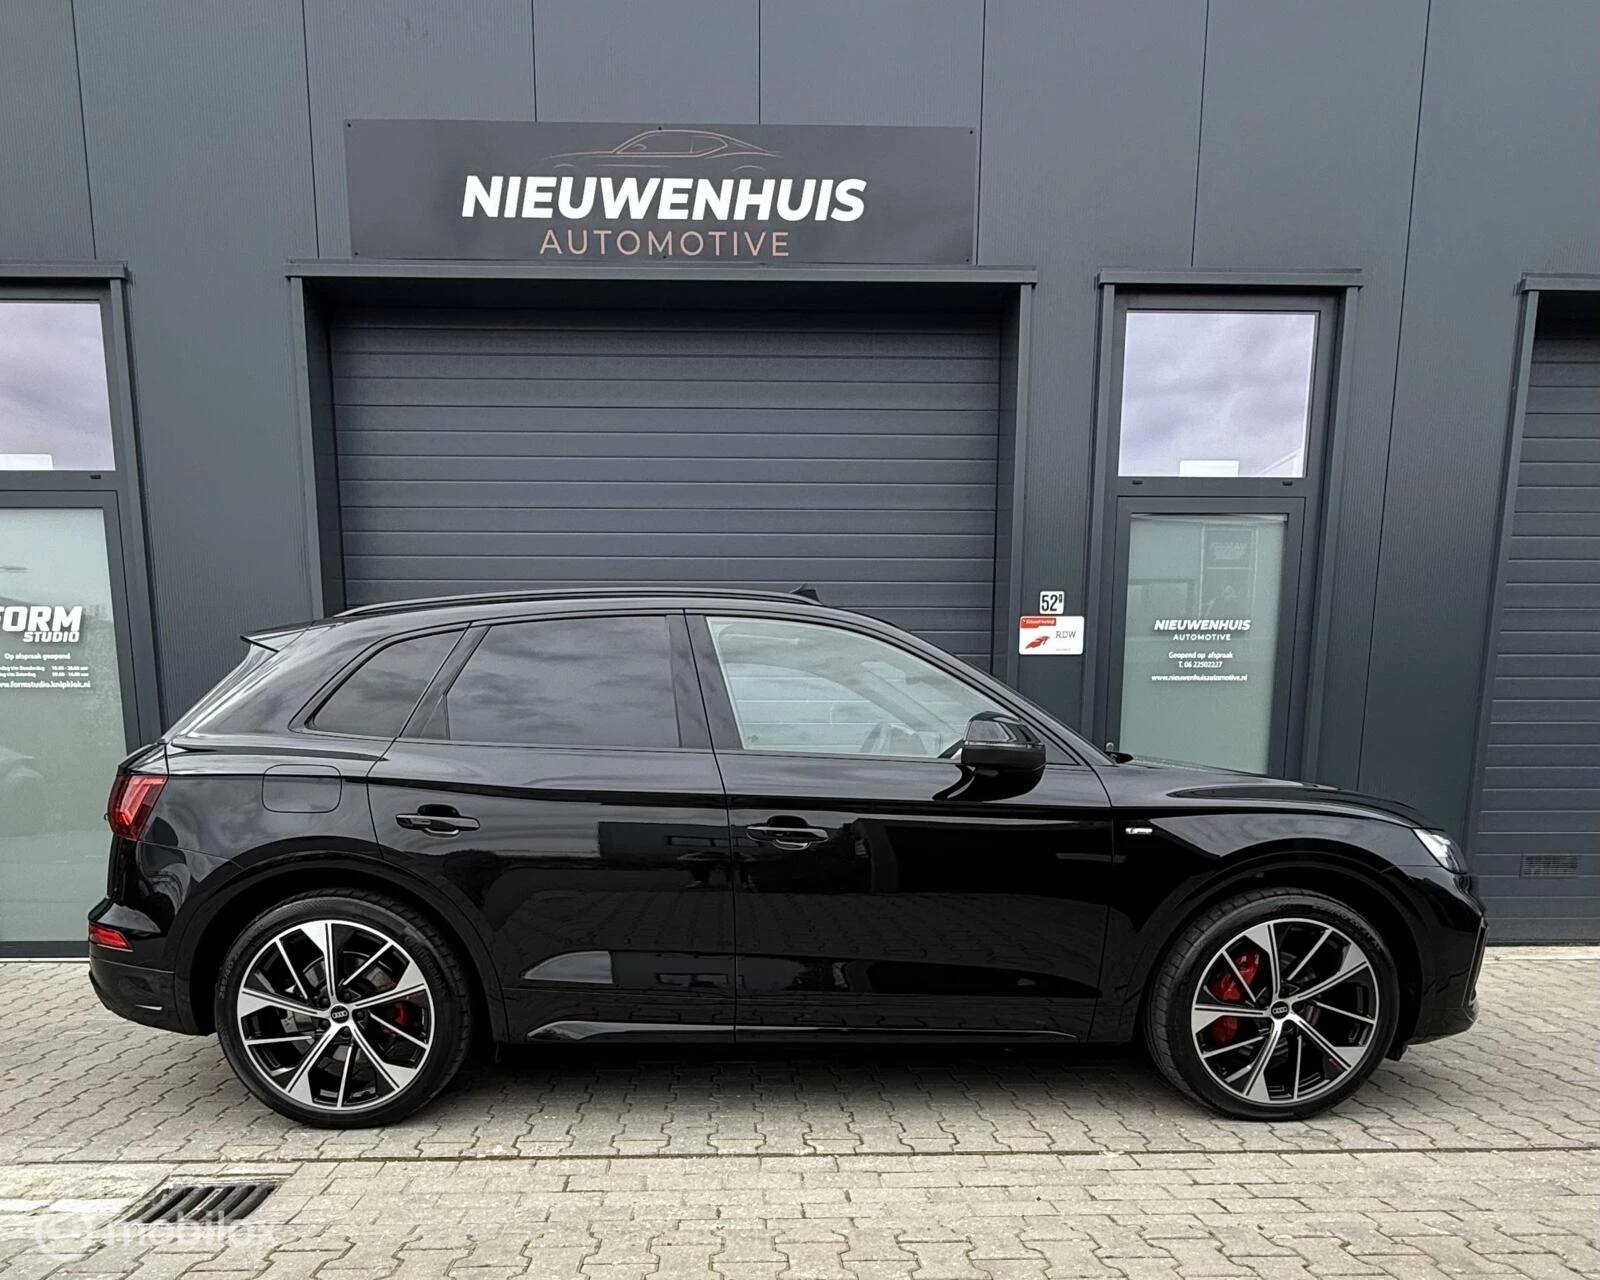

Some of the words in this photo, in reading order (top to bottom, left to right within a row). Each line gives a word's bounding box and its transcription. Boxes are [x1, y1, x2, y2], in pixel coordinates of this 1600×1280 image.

[462, 175, 867, 222] NIEUWENHUIS
[540, 229, 789, 257] AUTOMOTIVE
[1154, 620, 1251, 630] NIEUWENHUIS
[23, 631, 80, 642] STUDIO
